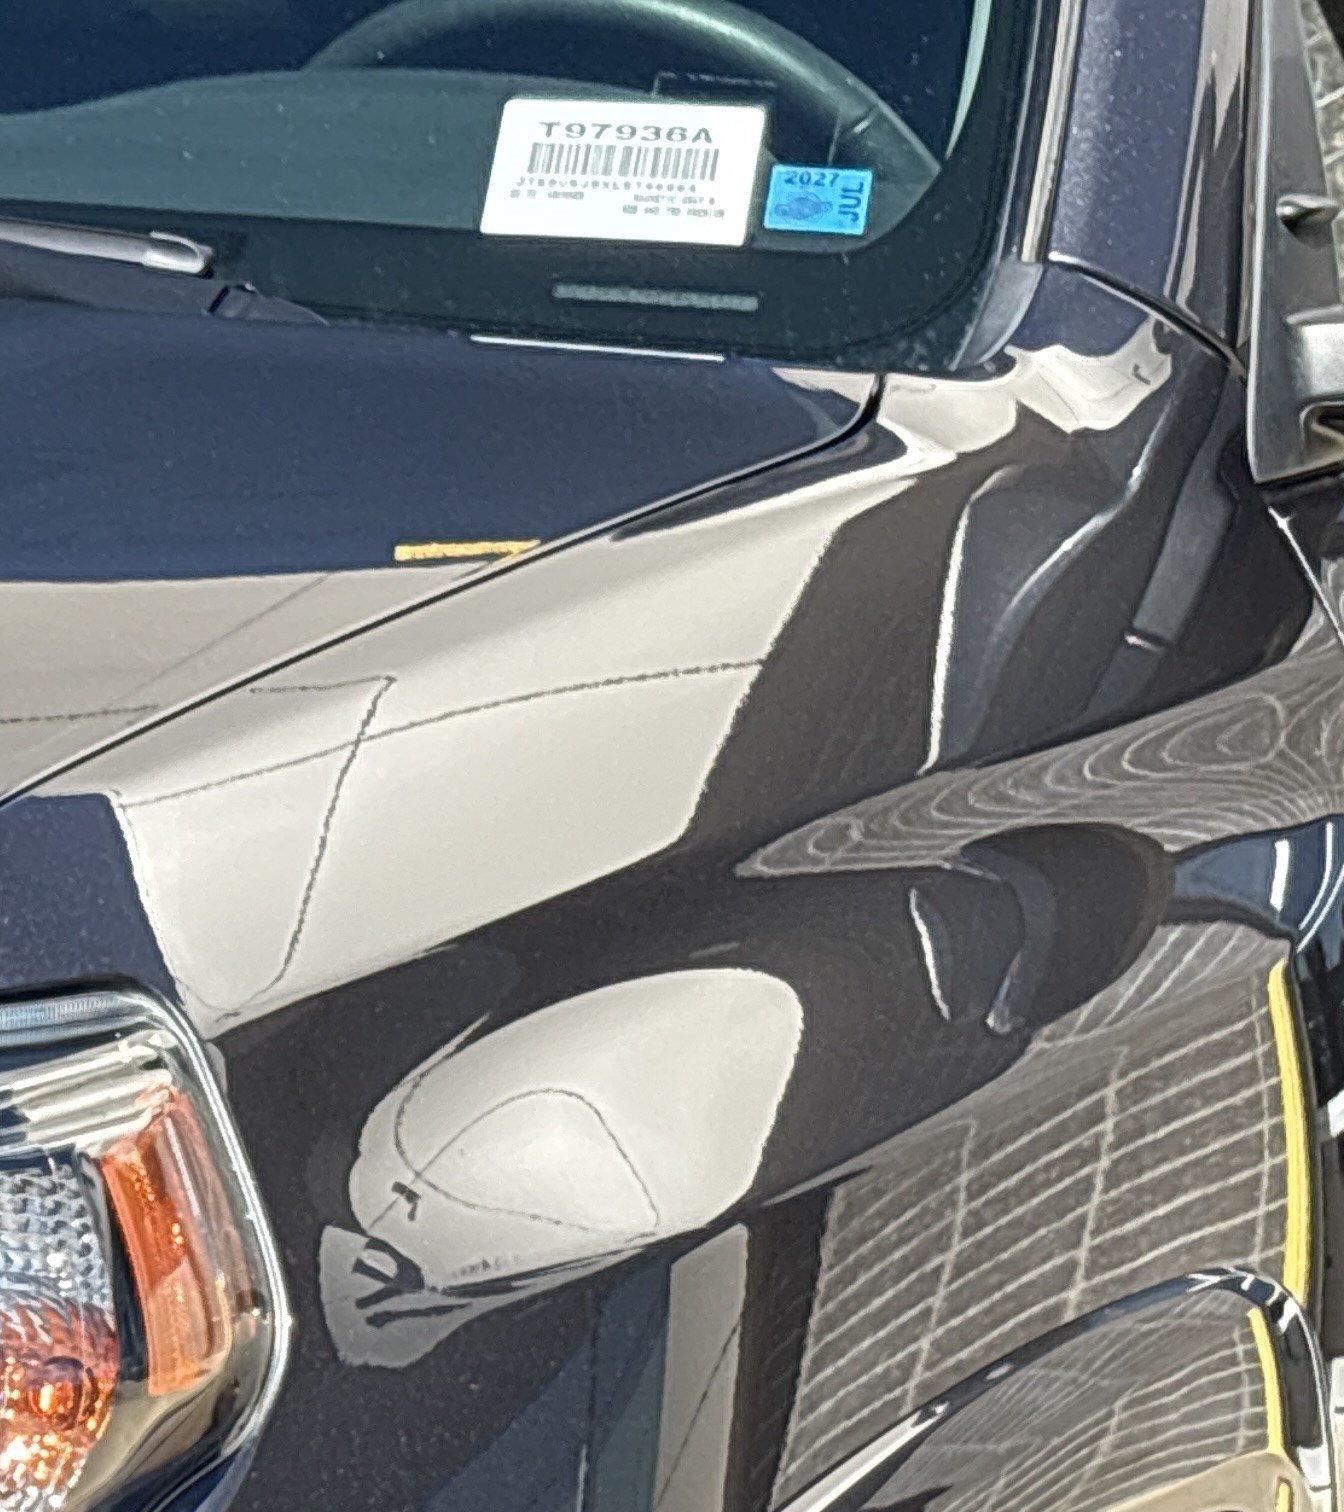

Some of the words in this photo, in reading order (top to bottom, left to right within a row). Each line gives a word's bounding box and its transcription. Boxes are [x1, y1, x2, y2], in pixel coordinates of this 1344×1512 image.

[539, 121, 713, 144] T97936A
[784, 170, 840, 188] 2027
[837, 181, 864, 223] JUL
